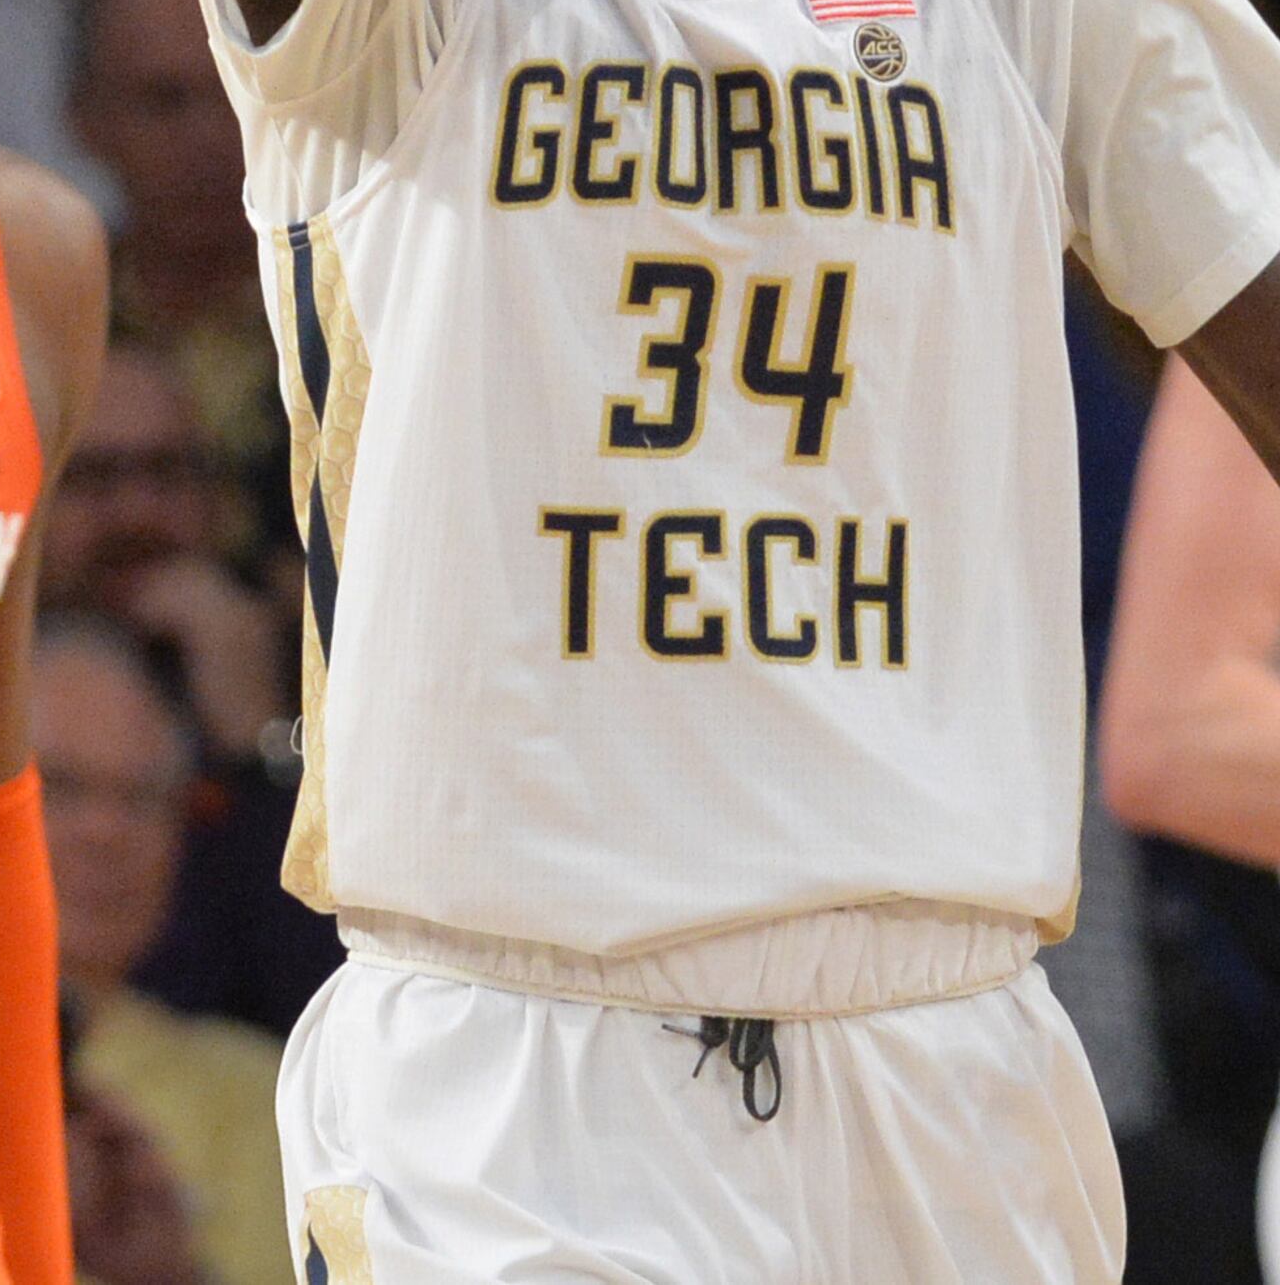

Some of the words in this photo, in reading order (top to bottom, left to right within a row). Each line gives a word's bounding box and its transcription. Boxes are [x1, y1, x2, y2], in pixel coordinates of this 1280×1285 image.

[863, 40, 901, 56] ACC
[490, 57, 956, 237] GEORGIA
[598, 252, 856, 466] 34
[537, 505, 909, 669] TECH
